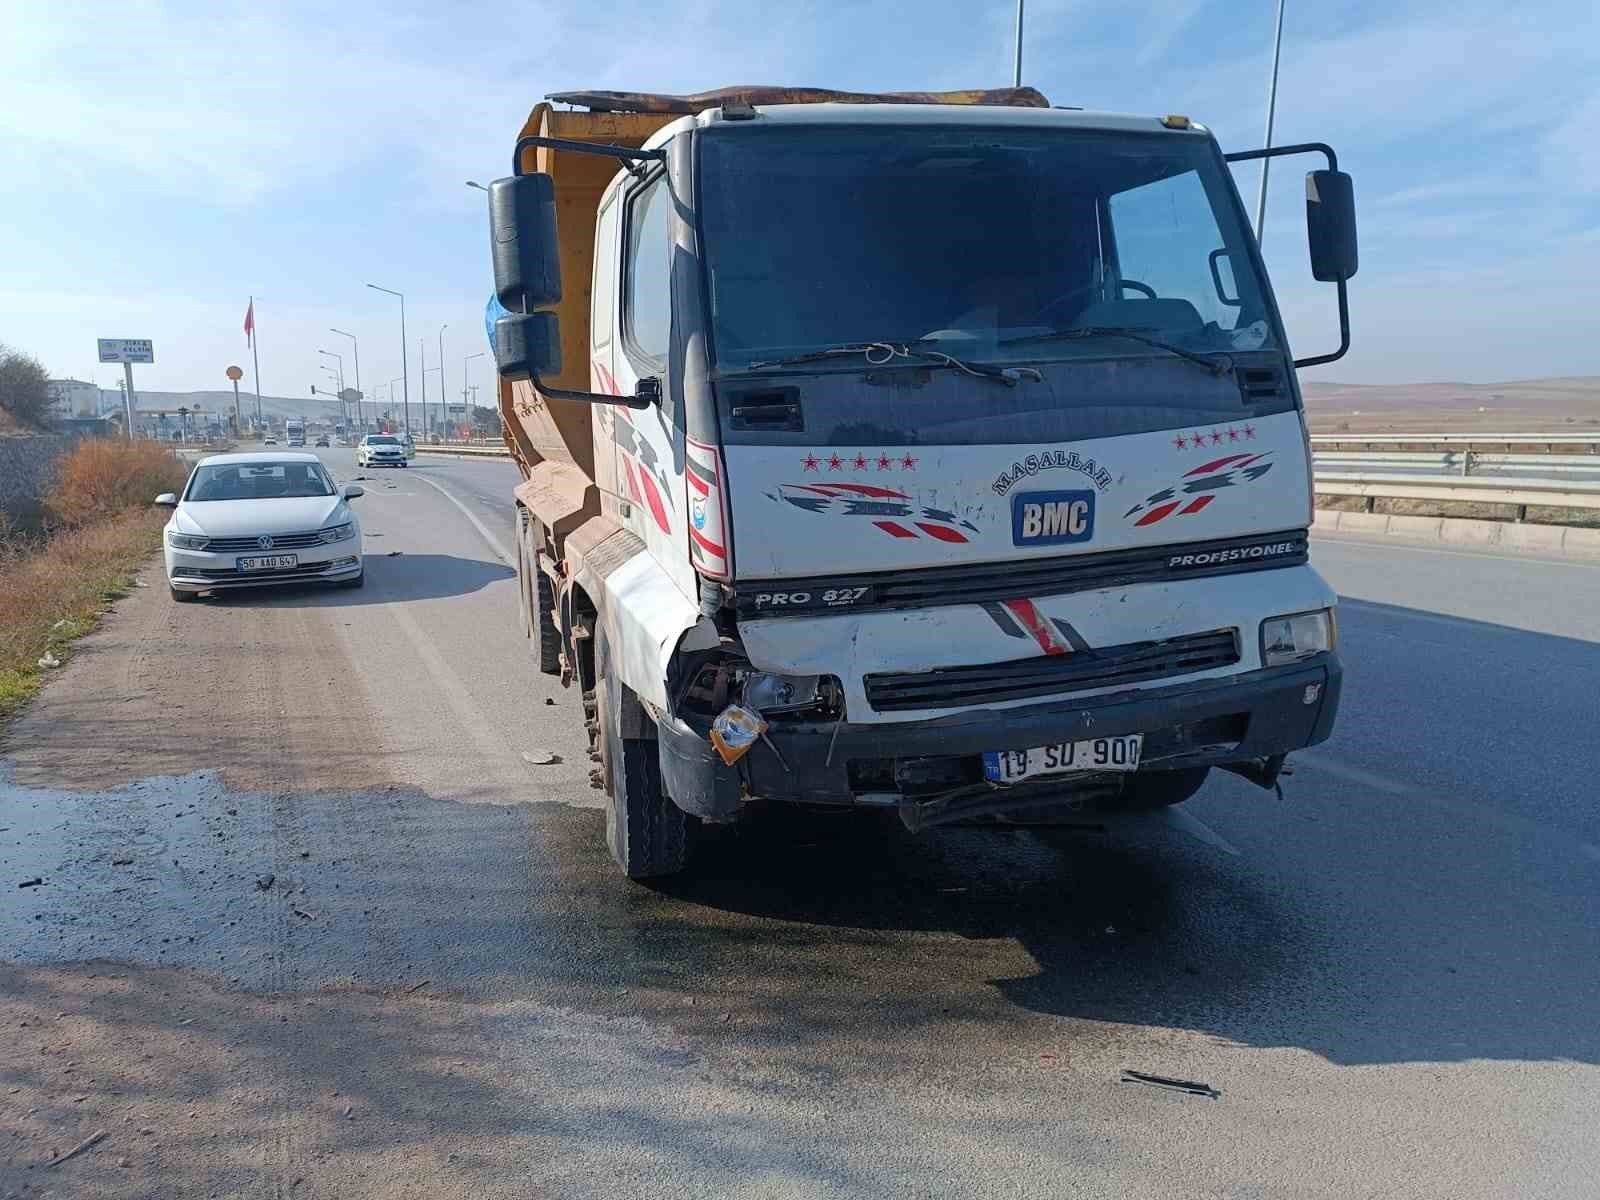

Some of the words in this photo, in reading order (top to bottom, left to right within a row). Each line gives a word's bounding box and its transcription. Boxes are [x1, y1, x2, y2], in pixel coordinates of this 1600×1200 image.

[1022, 500, 1088, 538] BMC
[1168, 543, 1295, 567] PROFESYONEL
[754, 592, 811, 608] PRO
[822, 587, 869, 601] 827
[1045, 741, 1075, 768] SU
